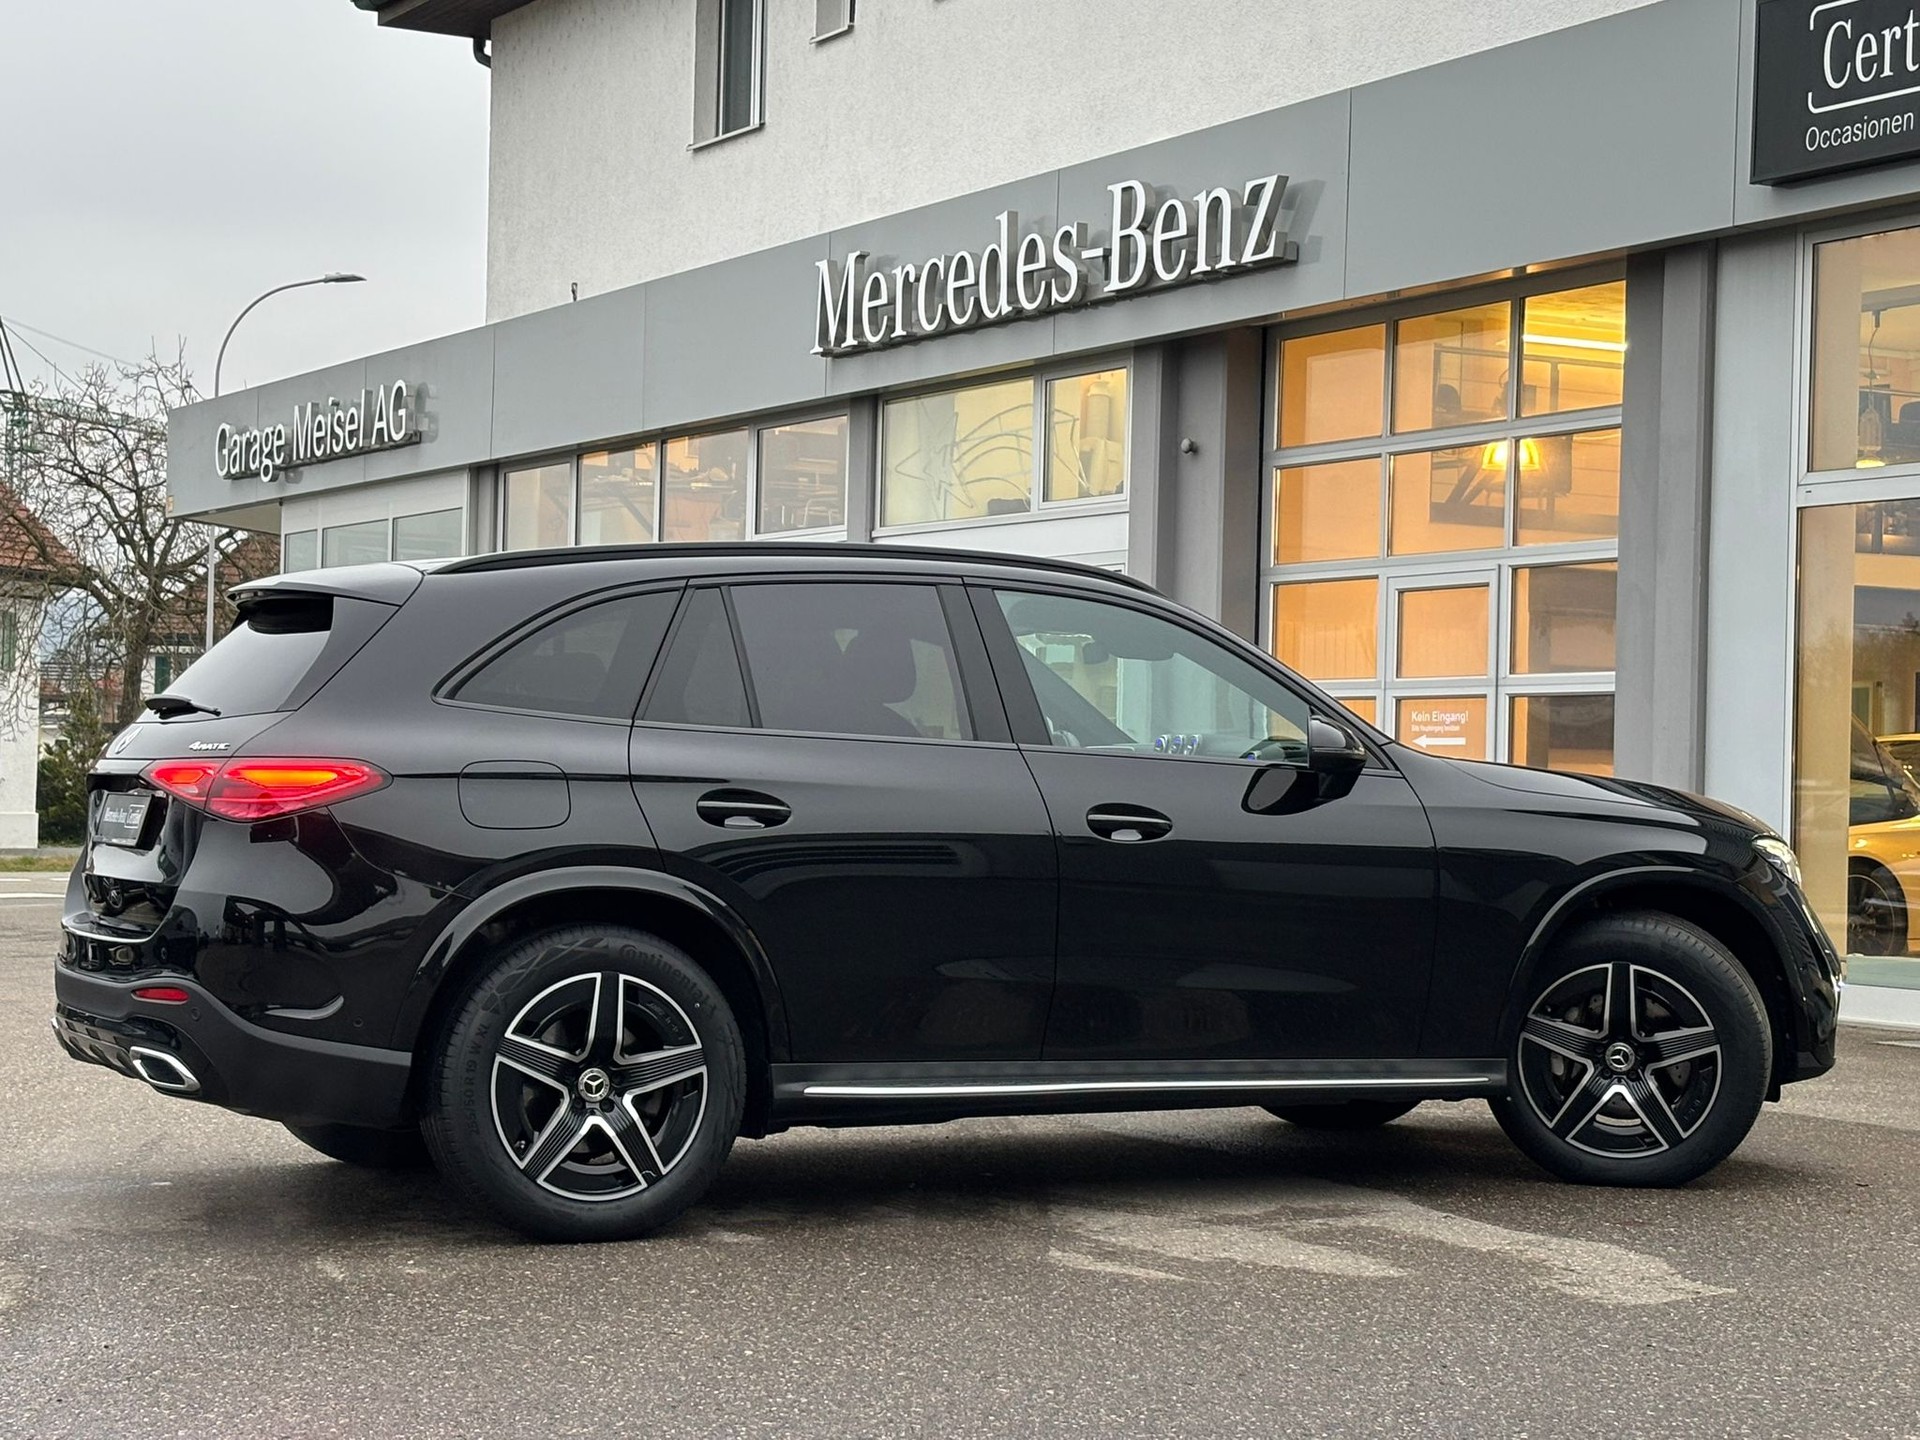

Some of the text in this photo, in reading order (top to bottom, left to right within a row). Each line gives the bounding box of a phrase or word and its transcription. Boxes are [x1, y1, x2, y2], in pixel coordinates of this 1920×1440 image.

[1805, 112, 1914, 152] Occasionen
[808, 174, 1289, 355] Mercedes-Benz
[215, 379, 407, 482] Garage Meisel AG
[1432, 711, 1469, 725] Eingang!
